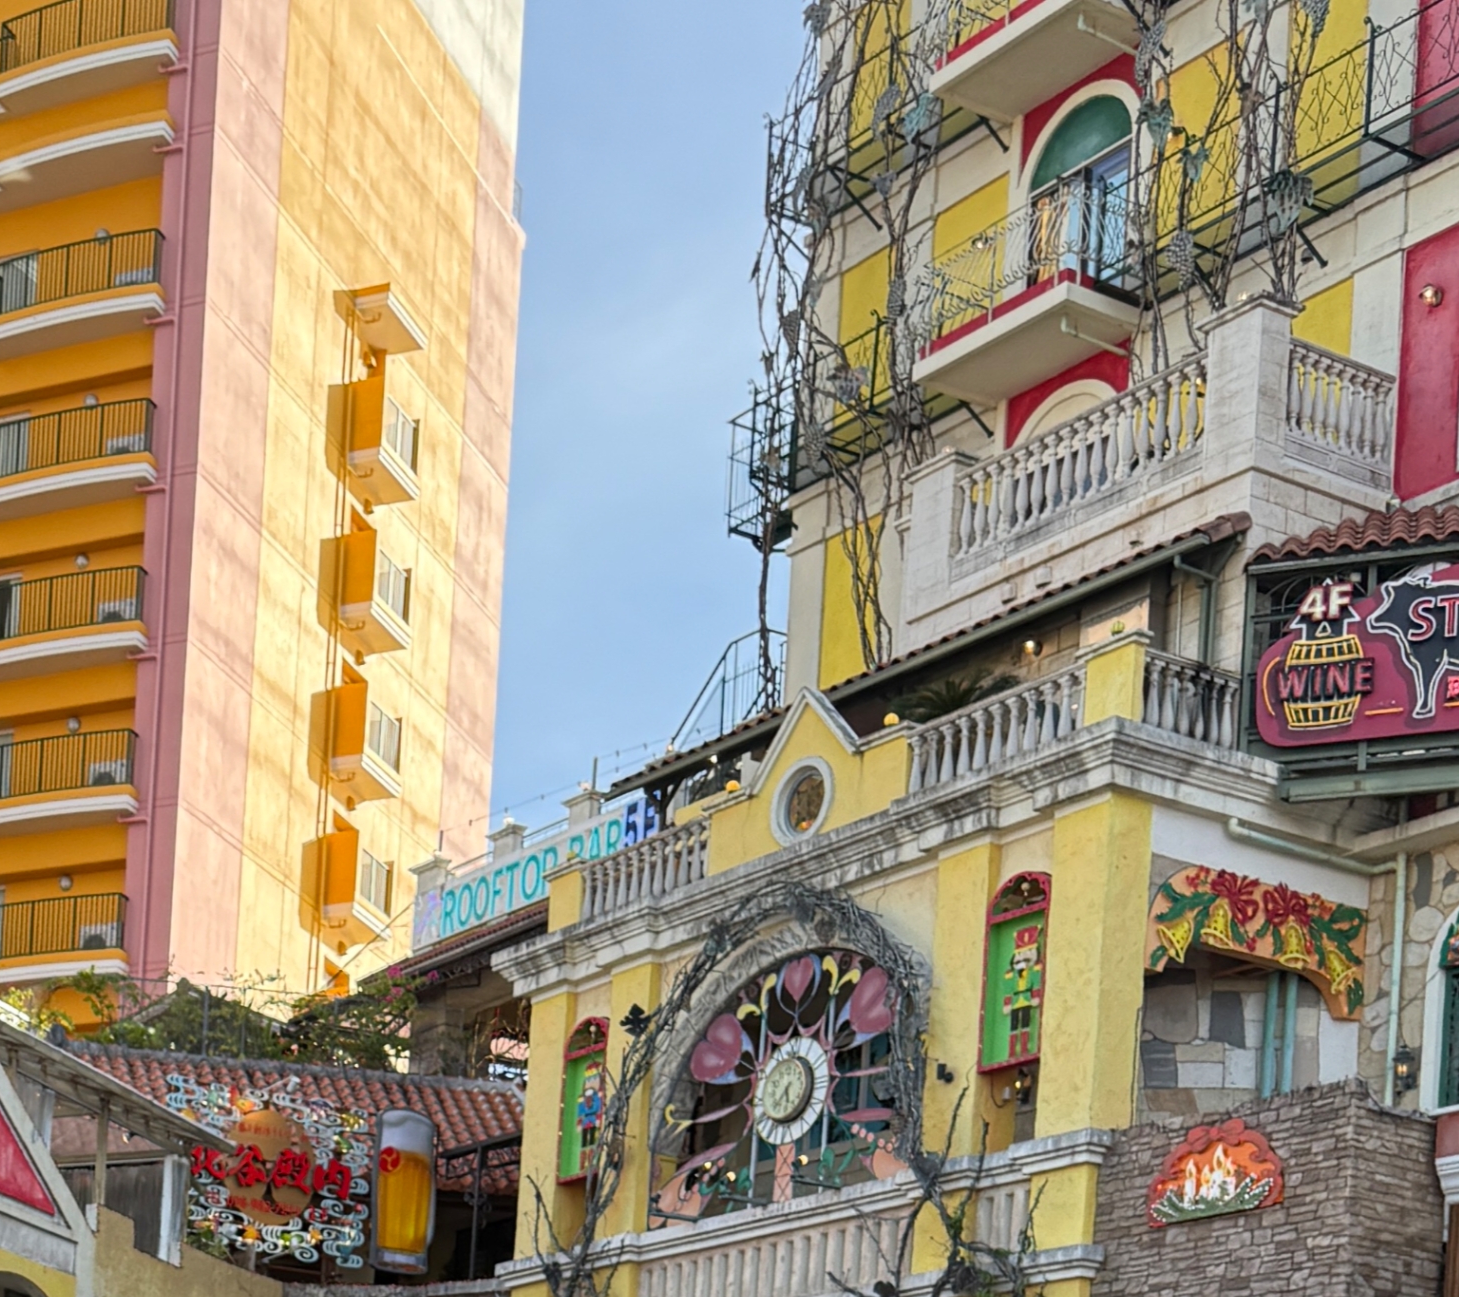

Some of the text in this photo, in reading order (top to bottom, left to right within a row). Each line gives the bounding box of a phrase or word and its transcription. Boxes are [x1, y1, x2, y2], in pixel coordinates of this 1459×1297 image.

[1299, 583, 1353, 621] 4F
[1278, 658, 1374, 699] WINE
[440, 845, 558, 936] ROOFTOP
